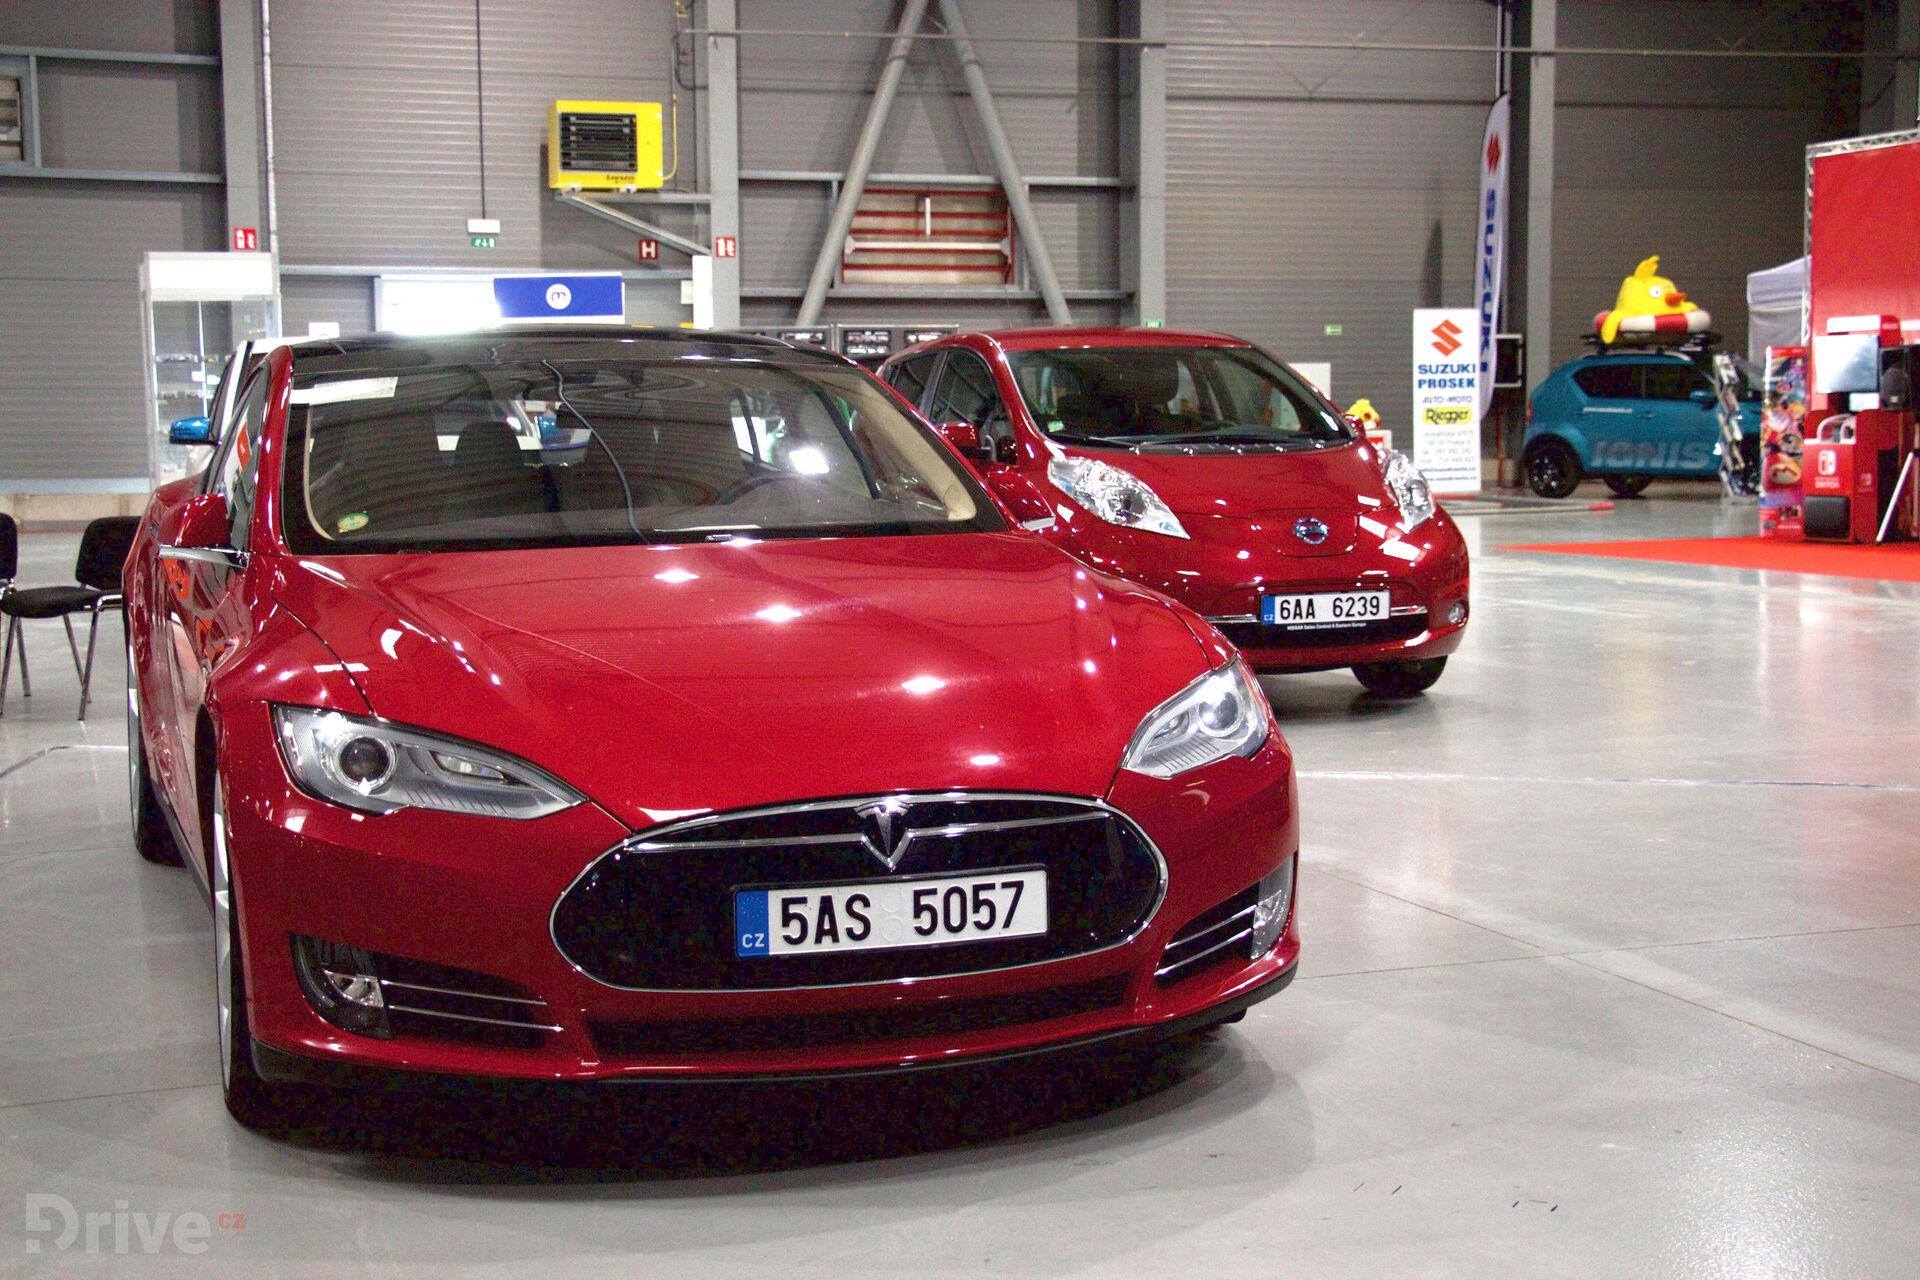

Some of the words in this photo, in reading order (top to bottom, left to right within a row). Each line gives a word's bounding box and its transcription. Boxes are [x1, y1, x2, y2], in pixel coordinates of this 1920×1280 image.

[1480, 189, 1496, 373] SUZUKI
[1418, 363, 1476, 374] SUZUKI
[1417, 378, 1475, 389] PROSEK
[1279, 598, 1316, 620] 6AA
[1332, 595, 1380, 618] 6239
[1263, 613, 1274, 621] CZ
[781, 892, 871, 946] 5AS
[912, 880, 1025, 937] 5057
[741, 933, 765, 949] CZ
